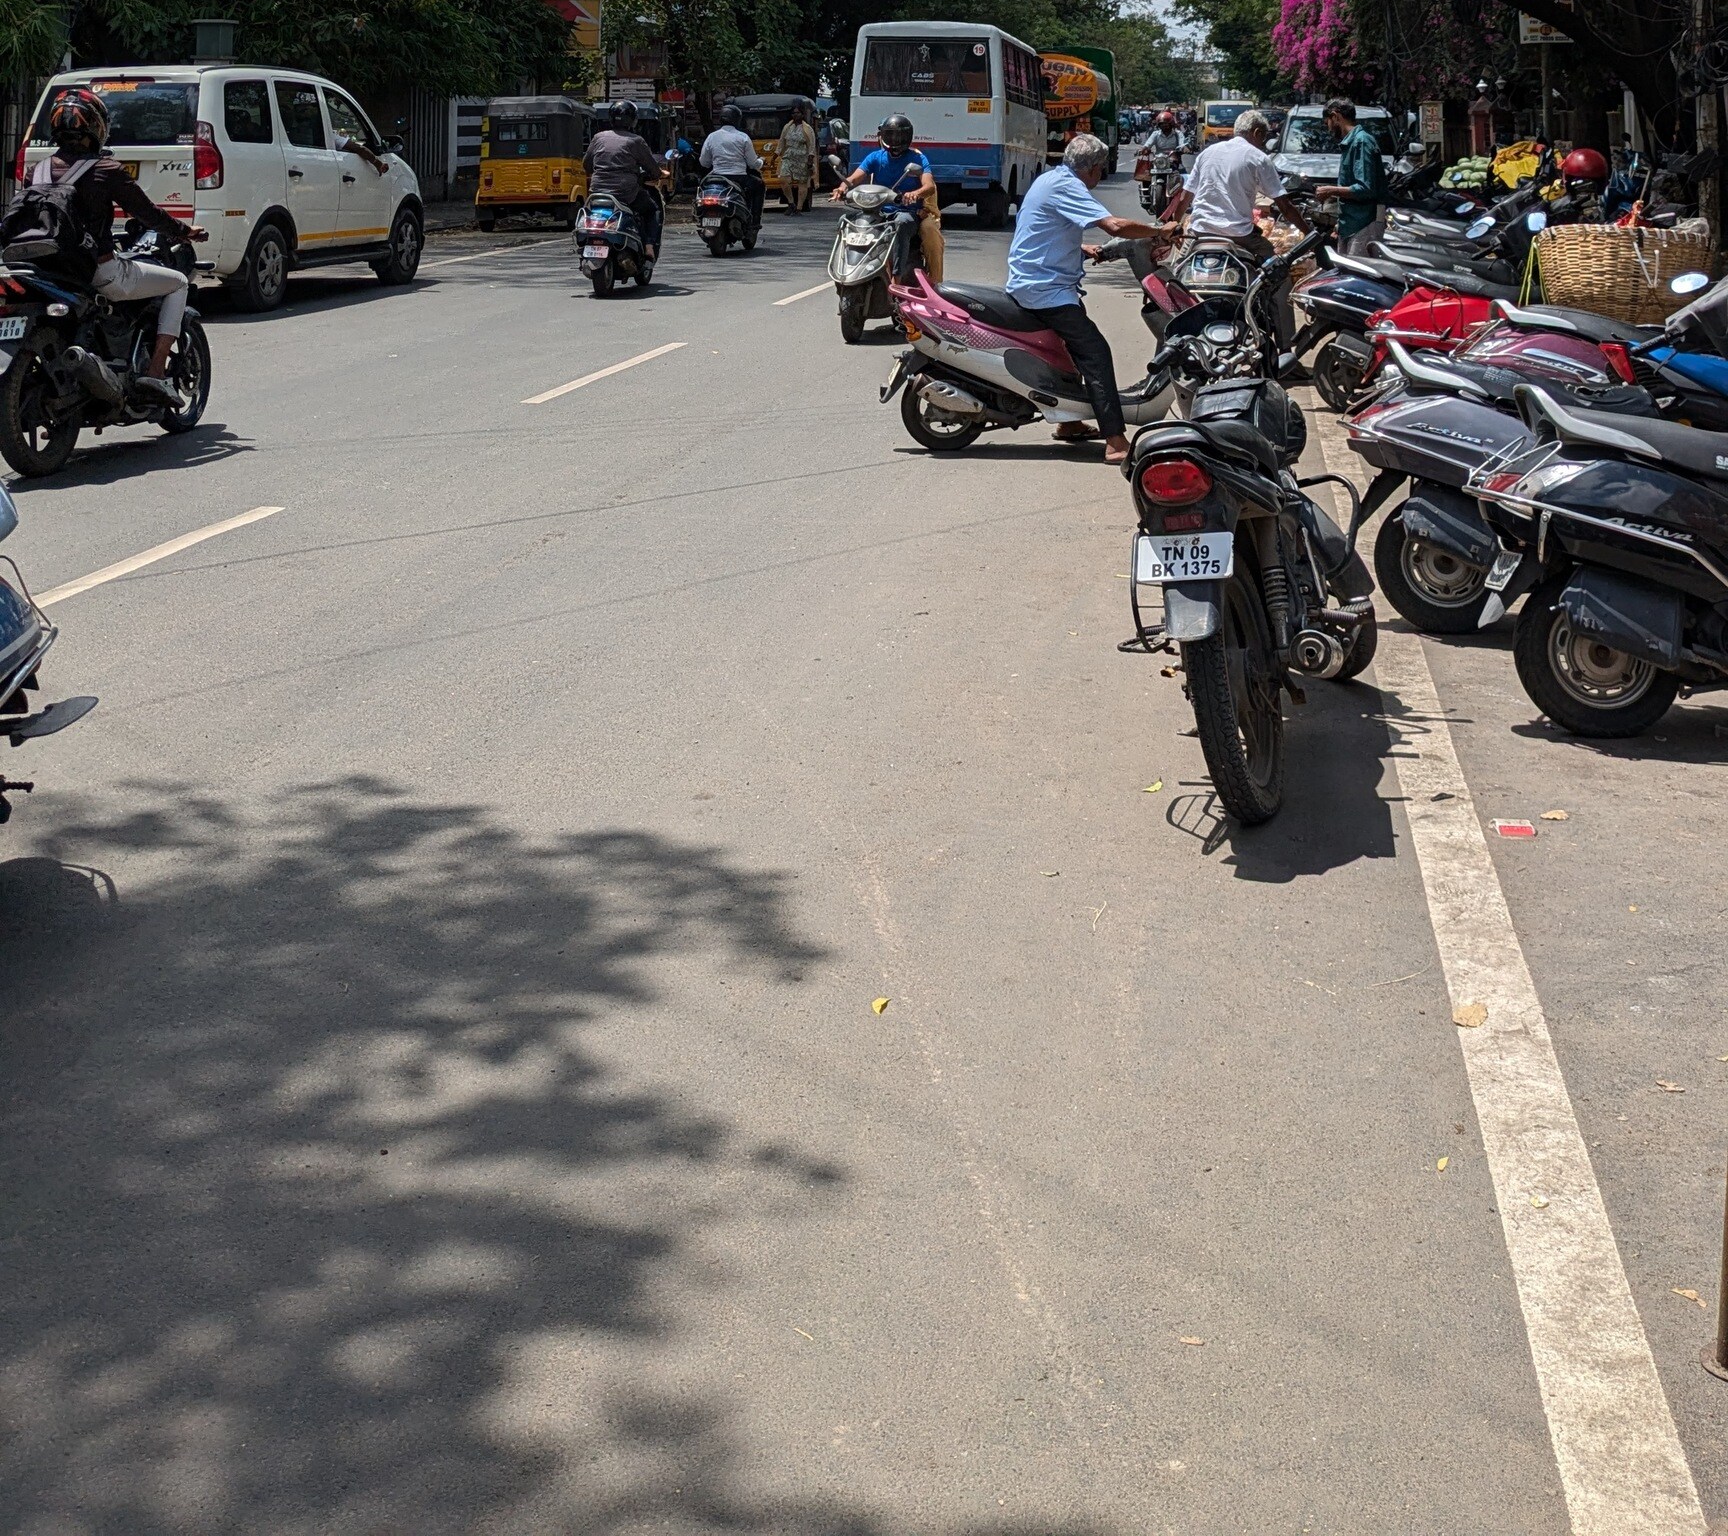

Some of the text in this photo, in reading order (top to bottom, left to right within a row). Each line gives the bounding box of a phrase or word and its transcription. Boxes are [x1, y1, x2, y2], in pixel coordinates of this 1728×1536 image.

[974, 46, 984, 54] 19
[1045, 104, 1081, 117] SUPPLY
[1406, 421, 1484, 446] Activa
[1605, 517, 1693, 542] Activa
[1162, 545, 1210, 561] TN 09
[1152, 560, 1220, 577] BK 1375
